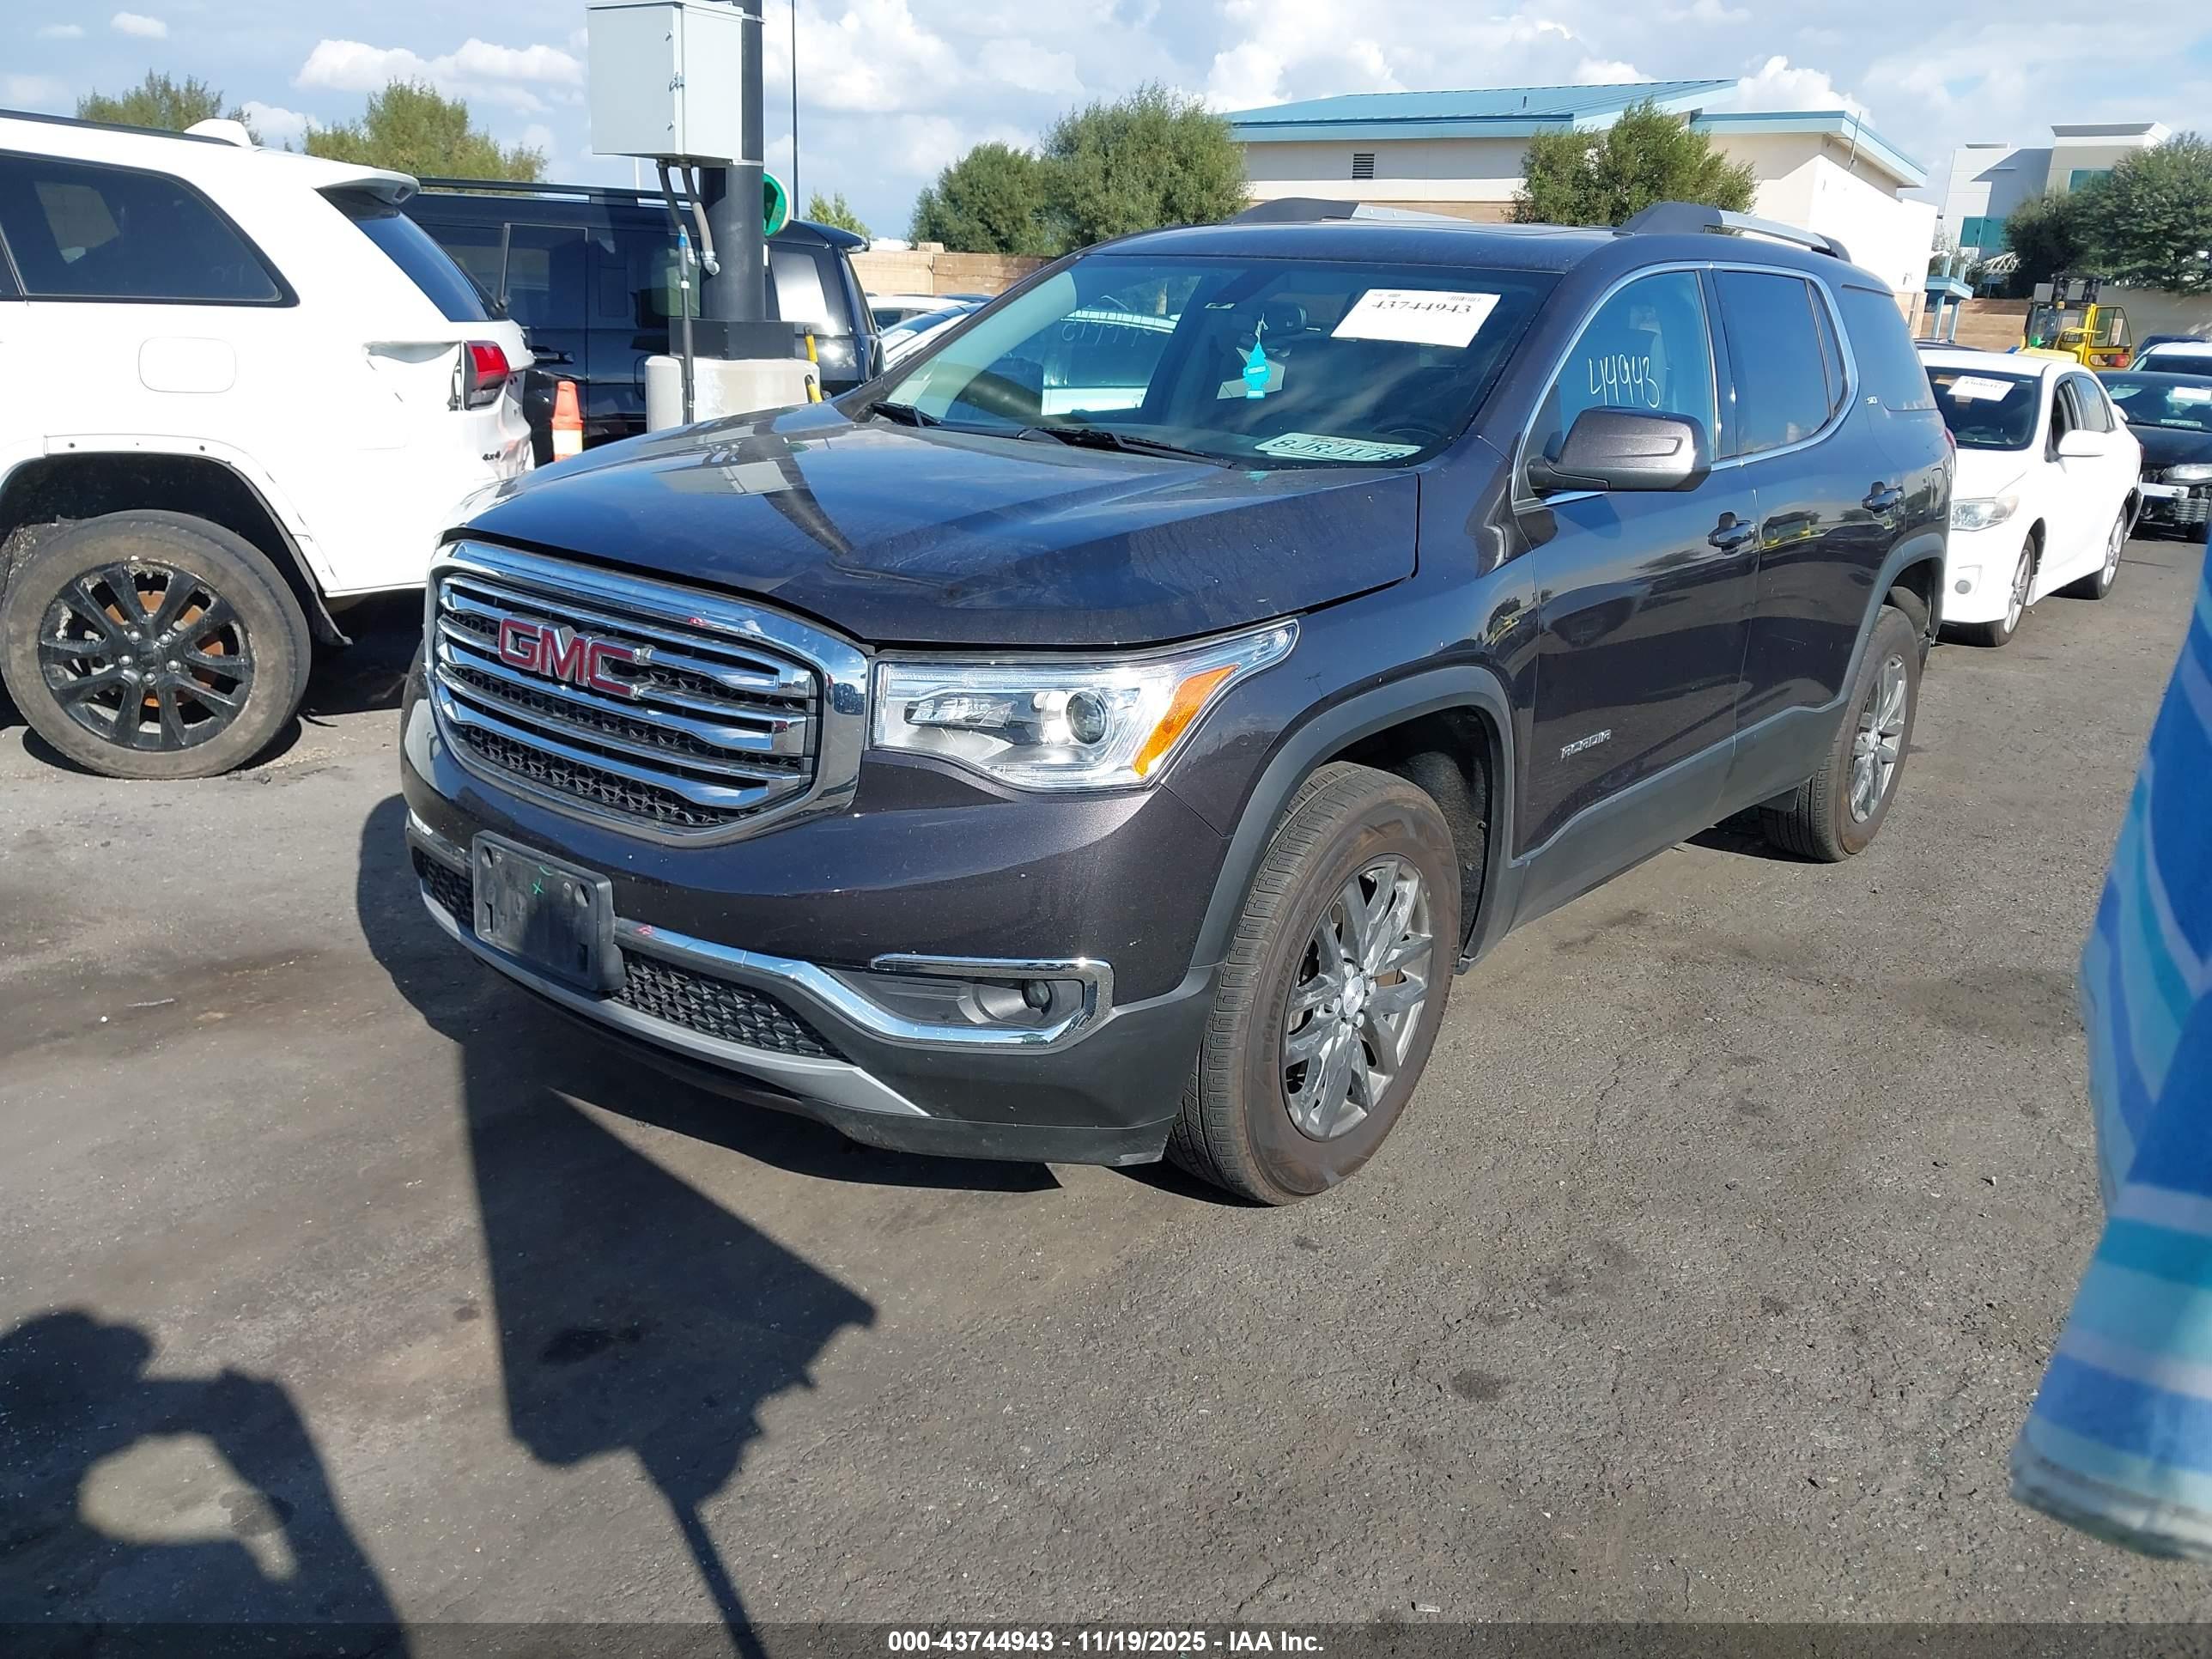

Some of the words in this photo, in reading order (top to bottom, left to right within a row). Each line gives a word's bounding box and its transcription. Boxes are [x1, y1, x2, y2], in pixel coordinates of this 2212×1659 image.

[1372, 300, 1472, 314] 43744943
[1588, 354, 1660, 409] 44943
[1272, 439, 1406, 461] 8JRJ178
[498, 617, 641, 701] GMC
